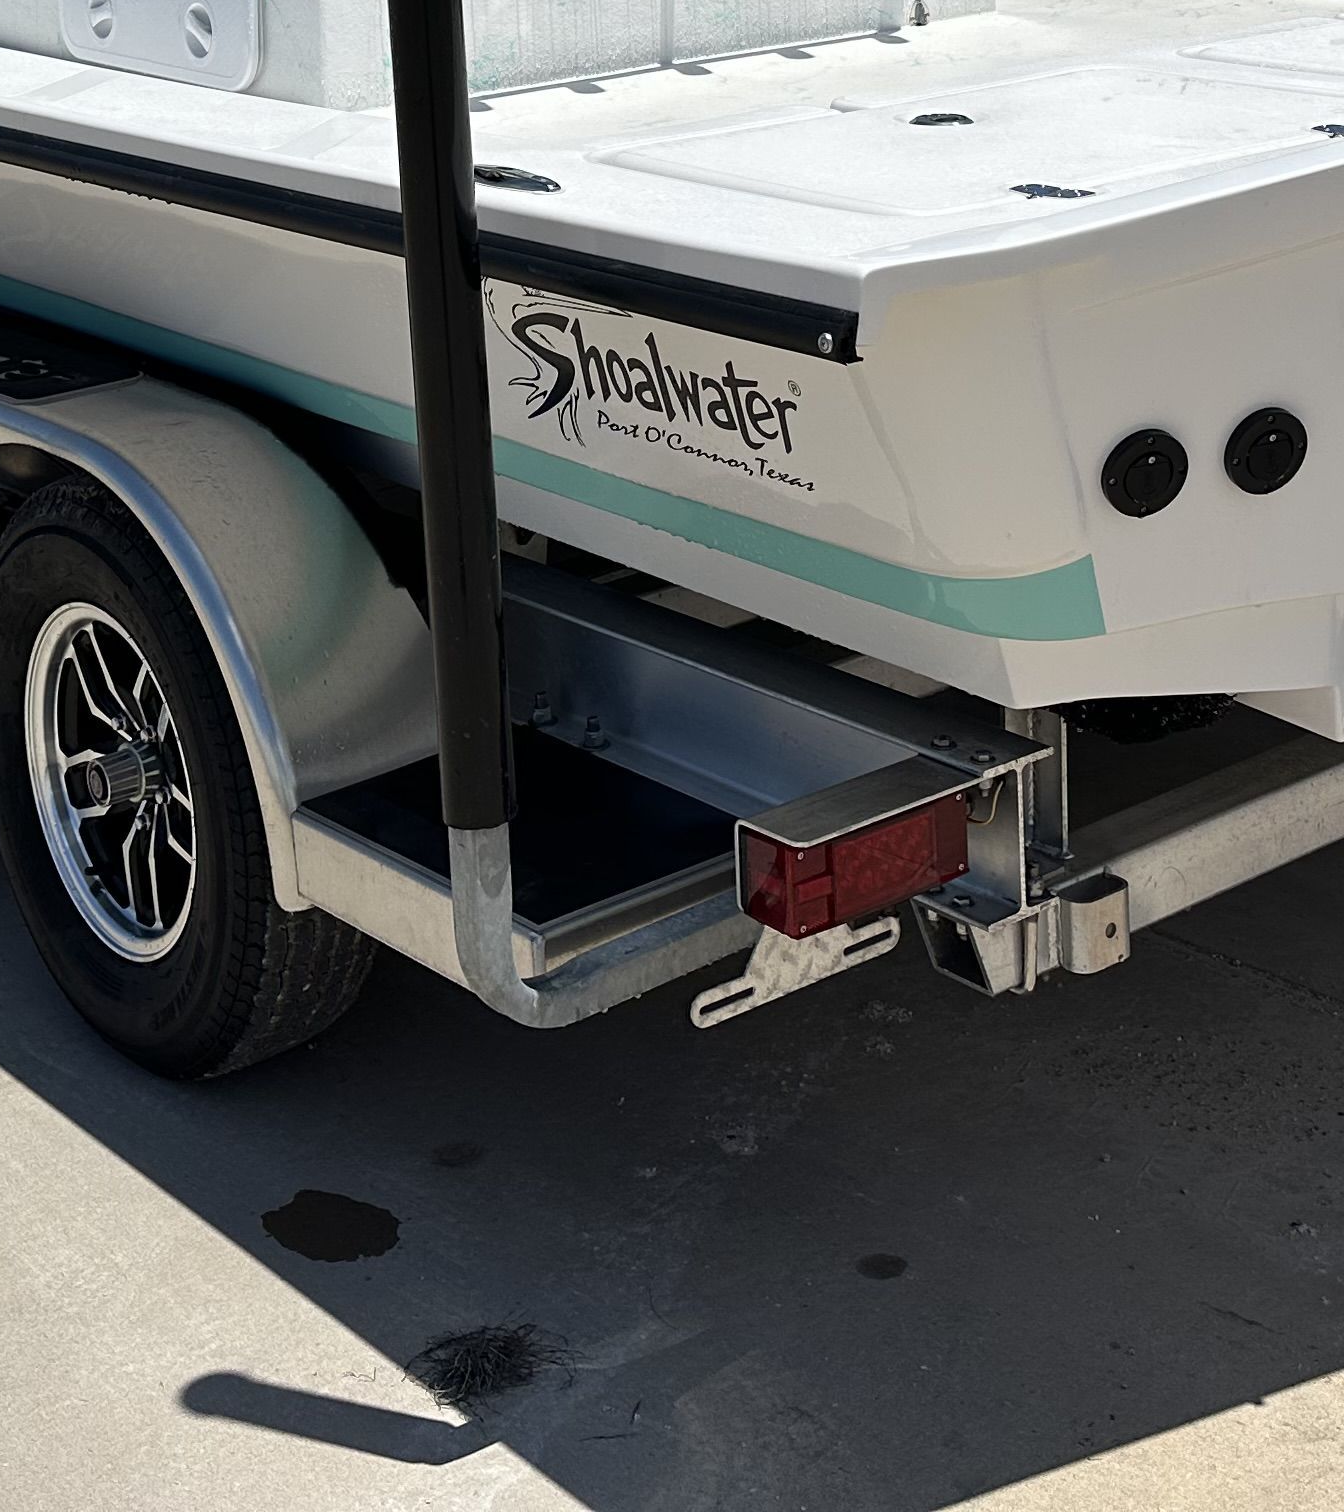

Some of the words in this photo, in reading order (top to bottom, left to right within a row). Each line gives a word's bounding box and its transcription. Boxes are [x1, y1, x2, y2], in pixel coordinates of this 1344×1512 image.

[512, 312, 798, 454] Shoalwater
[597, 409, 640, 438] Port
[755, 457, 816, 492] Texas
